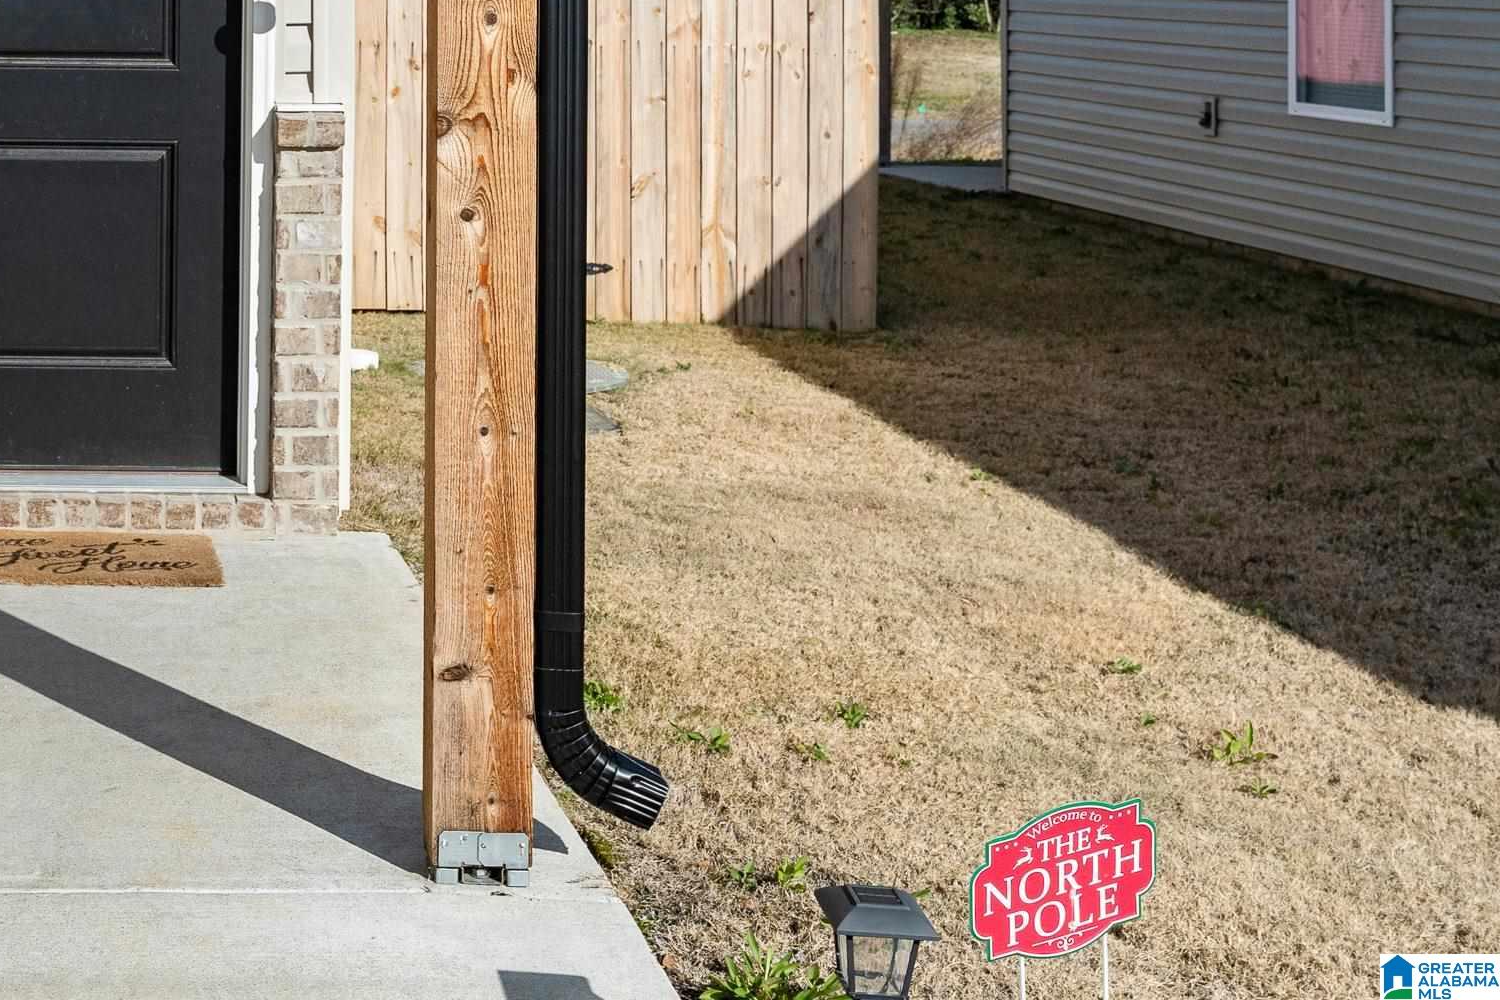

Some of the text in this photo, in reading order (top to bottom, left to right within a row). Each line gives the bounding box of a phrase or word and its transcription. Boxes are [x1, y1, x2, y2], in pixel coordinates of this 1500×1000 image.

[37, 555, 198, 574] Home
[1026, 809, 1102, 841] Welcome to
[1036, 826, 1092, 863] THE
[983, 838, 1144, 917] NORTH
[1006, 882, 1120, 948] POLE
